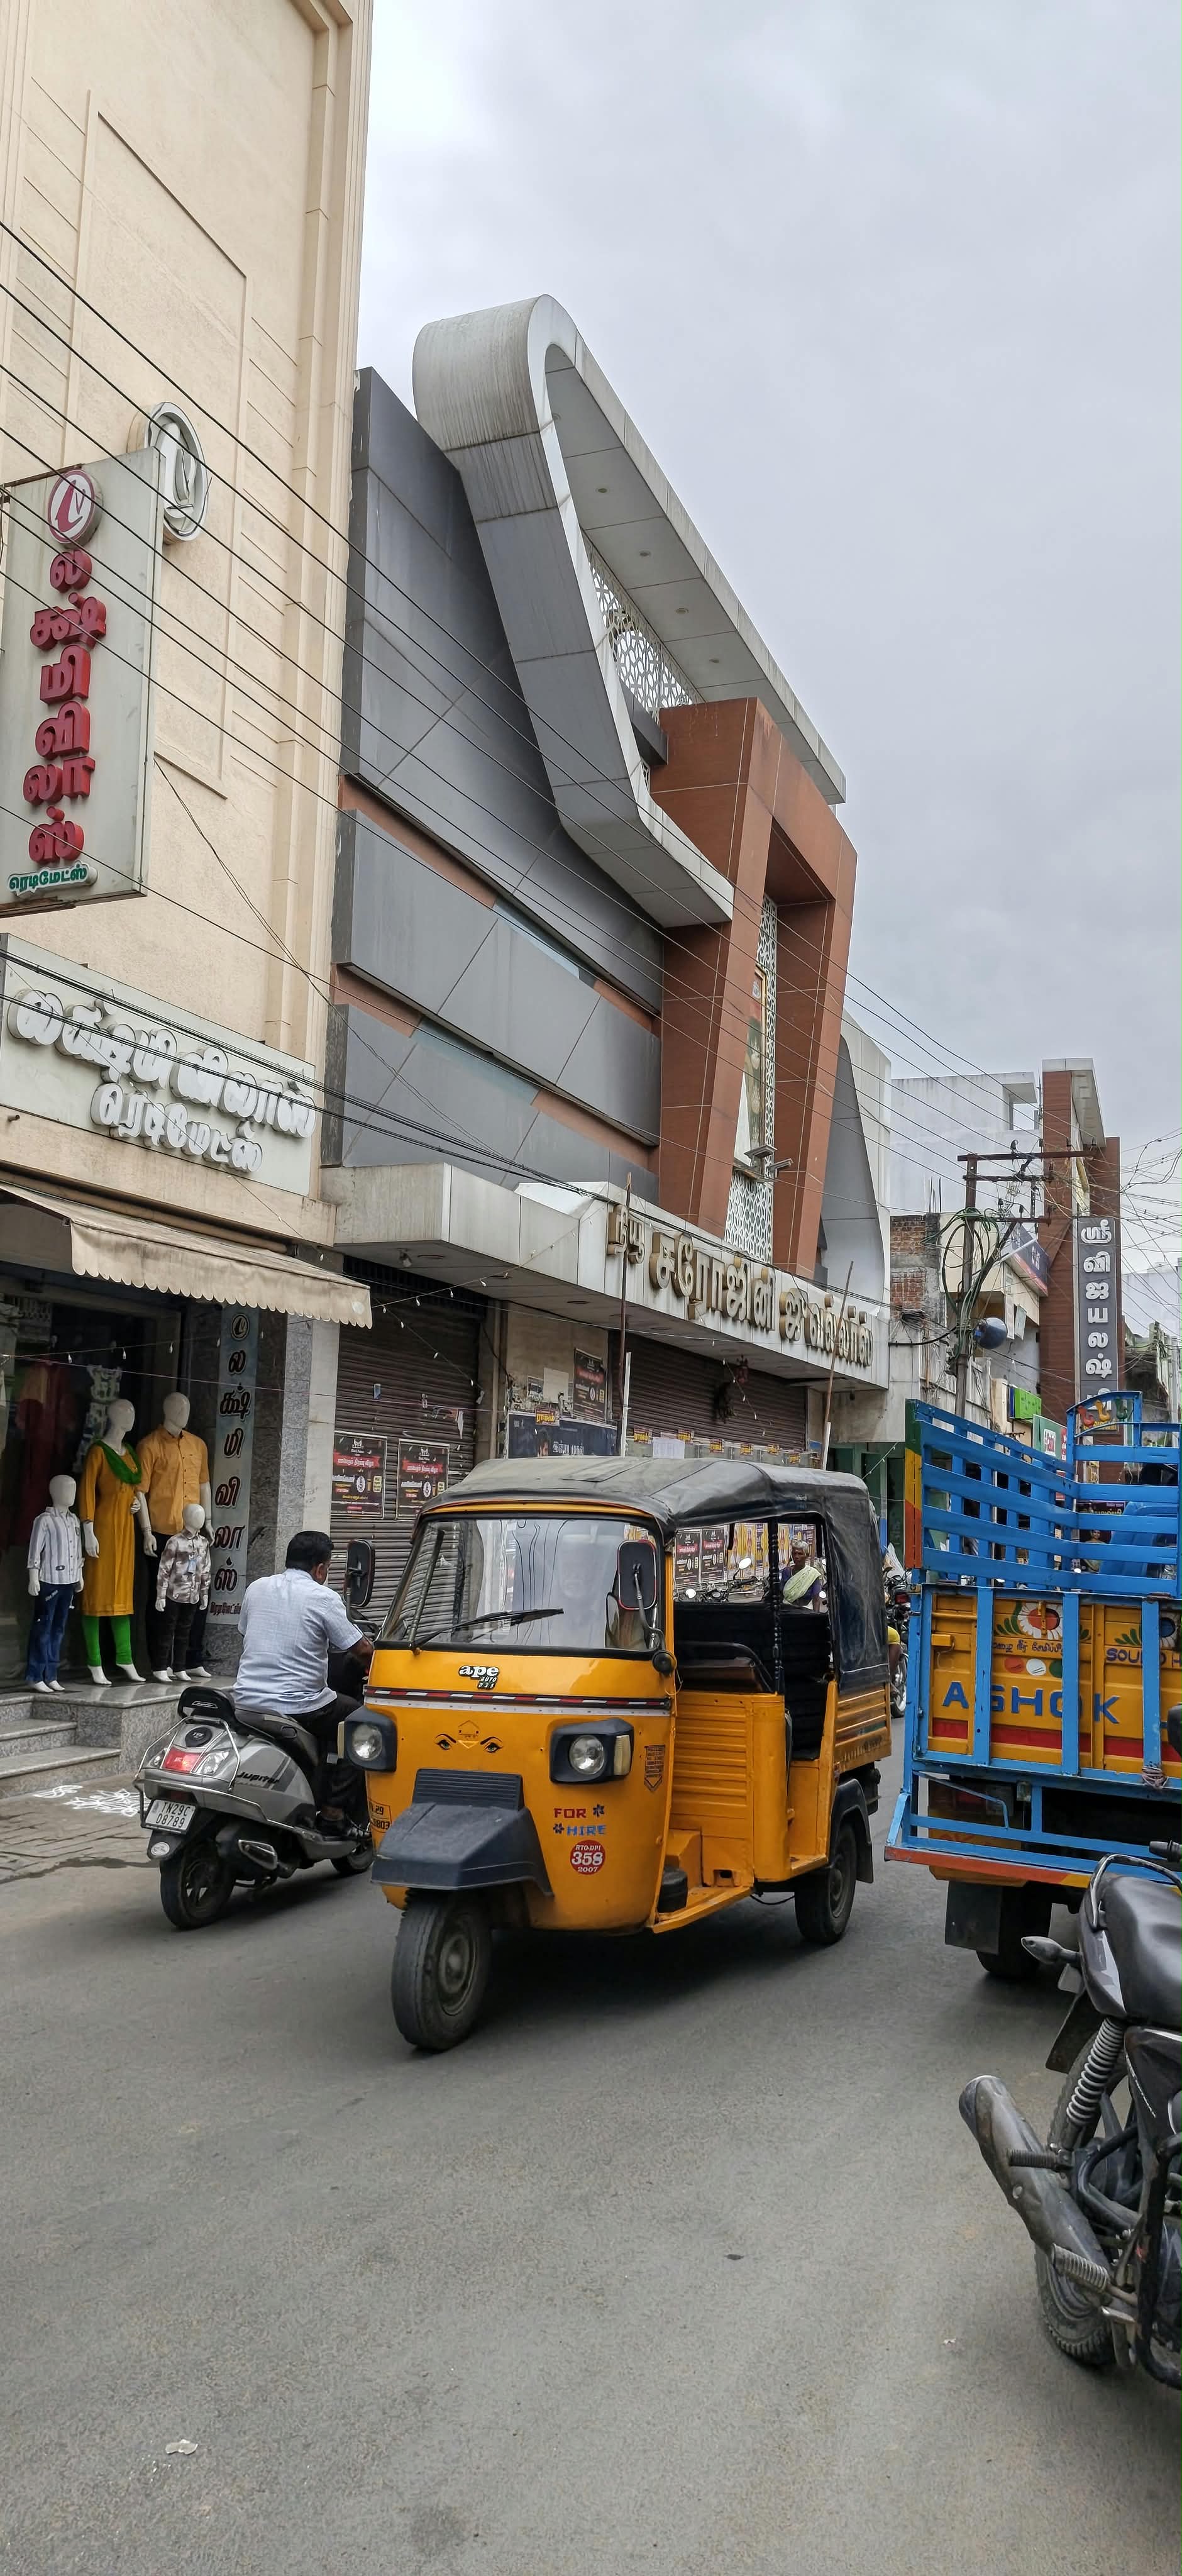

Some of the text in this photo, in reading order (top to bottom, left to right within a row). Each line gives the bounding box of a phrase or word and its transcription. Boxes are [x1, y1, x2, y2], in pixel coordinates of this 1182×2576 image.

[9, 864, 87, 891] ரெடிமேட்ஸ்
[459, 1665, 499, 1678] ape
[162, 1801, 191, 1816] TN29C
[554, 1807, 586, 1818] FOR
[566, 1825, 606, 1836] HIRE
[571, 1851, 603, 1865] 358
